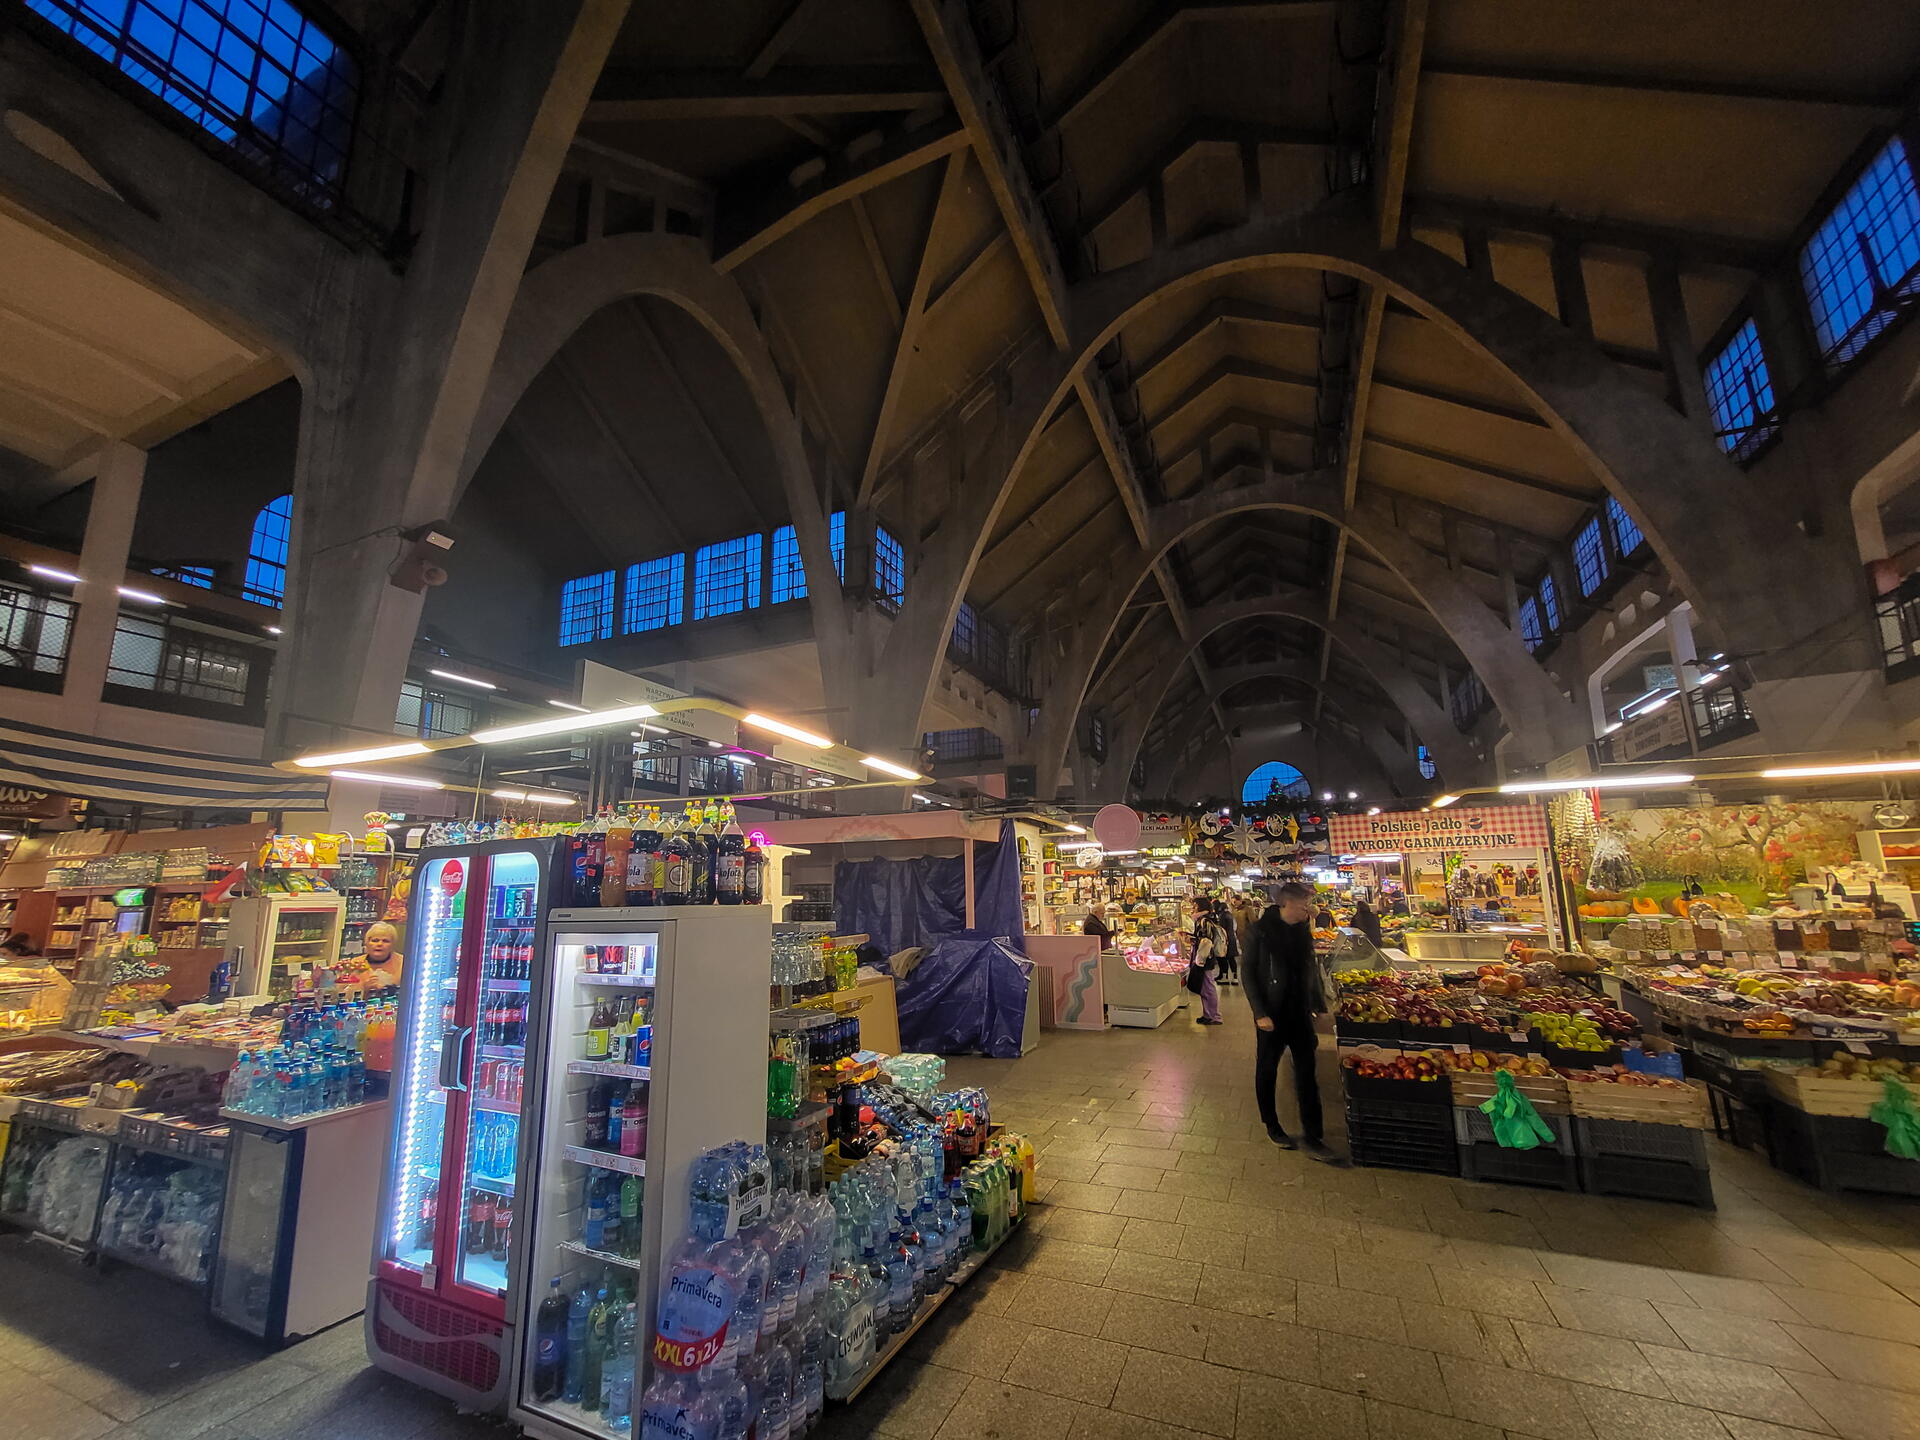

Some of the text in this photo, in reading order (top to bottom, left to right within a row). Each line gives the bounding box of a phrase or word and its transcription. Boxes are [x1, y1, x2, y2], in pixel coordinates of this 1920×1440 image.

[1371, 817, 1462, 834] Polskie Jadło
[1348, 832, 1516, 851] WYROBY GARMAŻERYJNE
[670, 1276, 723, 1309] Primavera
[653, 1336, 683, 1367] XXL
